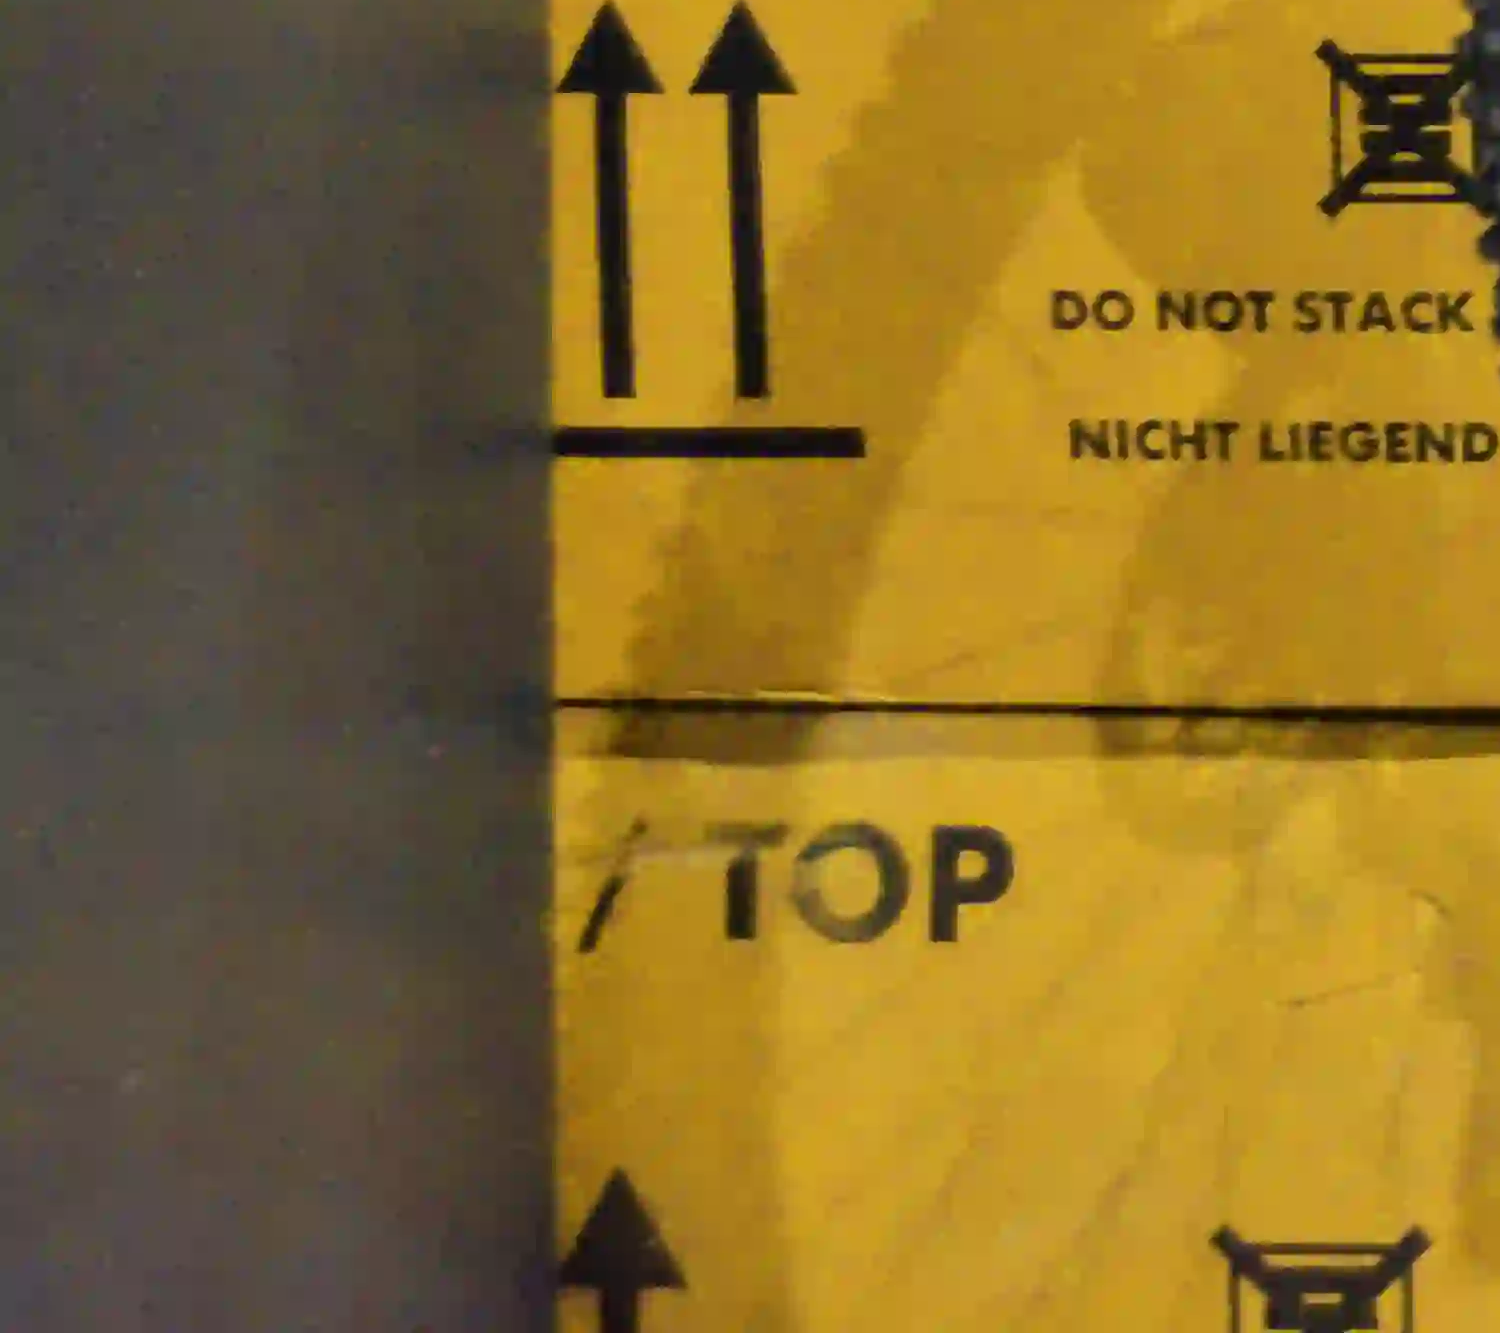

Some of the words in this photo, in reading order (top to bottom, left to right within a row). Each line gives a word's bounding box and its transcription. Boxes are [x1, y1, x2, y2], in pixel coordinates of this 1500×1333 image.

[1051, 290, 1135, 332] DO
[1156, 290, 1276, 334] NOT
[1292, 290, 1475, 334] STACK
[1068, 419, 1242, 463] NICHT
[1258, 421, 1500, 465] LIEGEND
[706, 821, 1015, 944] TOP
